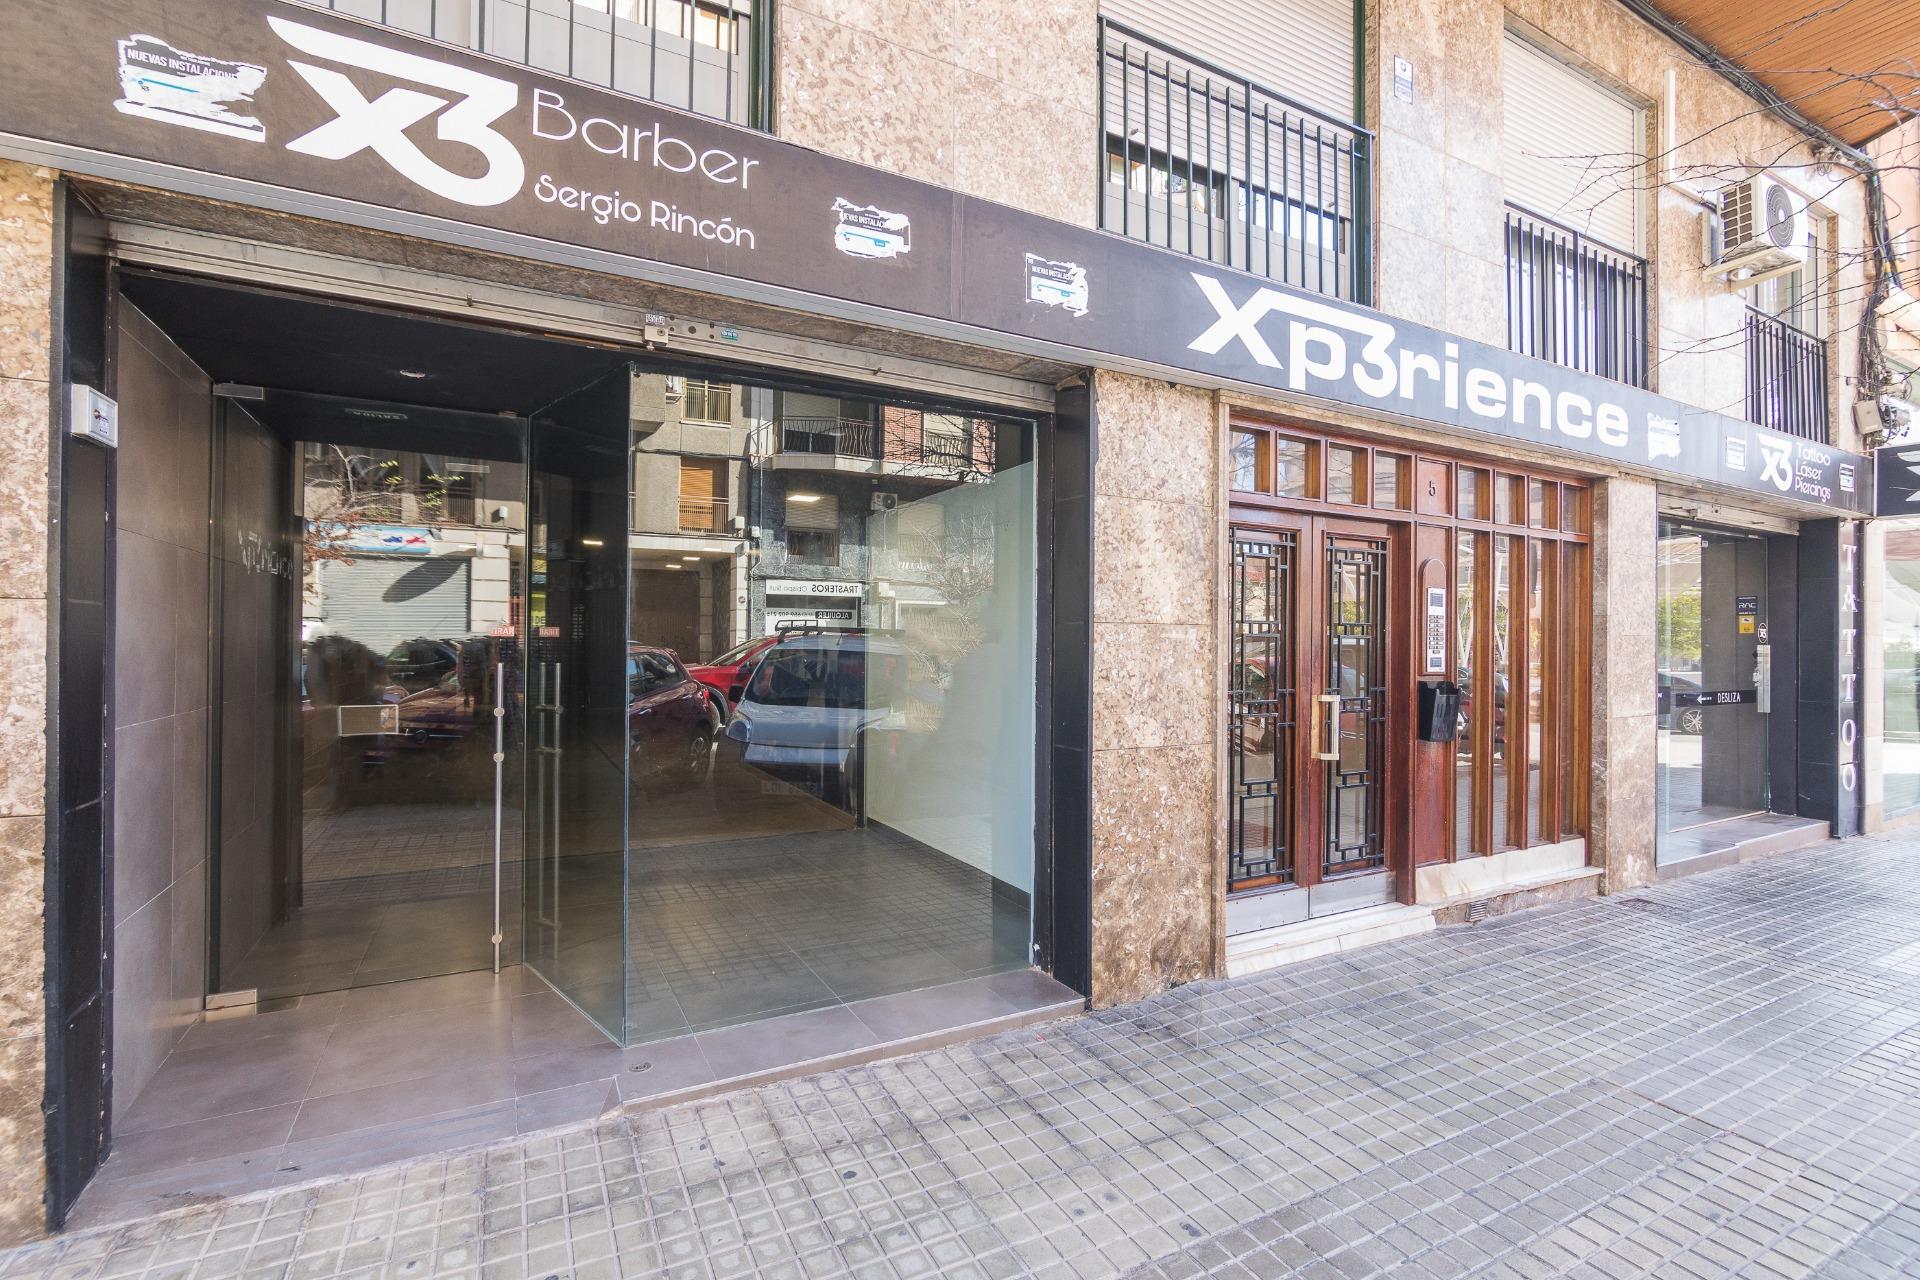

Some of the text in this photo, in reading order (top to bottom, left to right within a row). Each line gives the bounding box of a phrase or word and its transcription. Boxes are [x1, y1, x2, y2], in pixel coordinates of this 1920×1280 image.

[127, 48, 168, 67] NUEVAS
[532, 88, 759, 189] Barber
[534, 175, 755, 250] Sergio Rincón
[841, 212, 859, 222] UEVAS
[1187, 272, 1628, 447] Xp3rience
[1796, 442, 1831, 466] Tattoo
[1796, 460, 1823, 480] Láser
[1794, 476, 1831, 502] Piercings
[1841, 544, 1857, 791] TATTOO
[1717, 692, 1741, 703] DESLIZA
